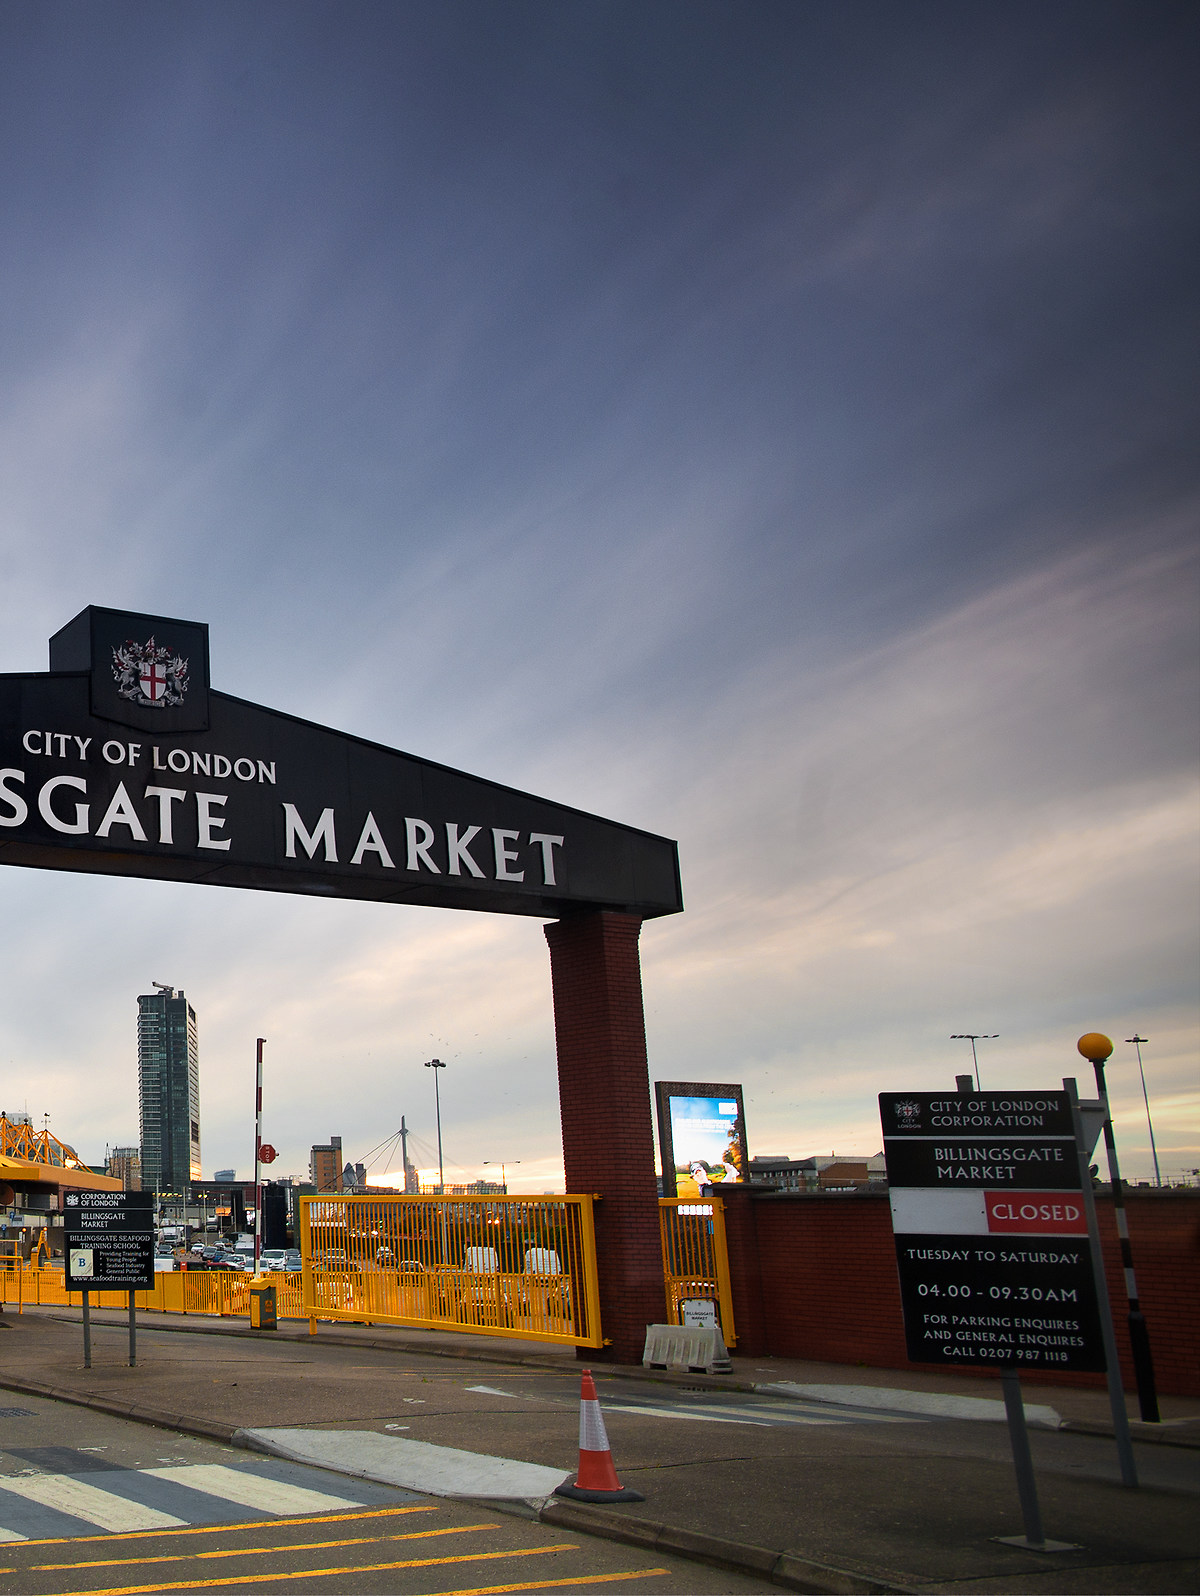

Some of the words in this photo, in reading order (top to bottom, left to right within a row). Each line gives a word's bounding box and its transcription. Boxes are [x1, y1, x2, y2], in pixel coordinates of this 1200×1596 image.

[22, 729, 93, 761] CITY
[101, 740, 142, 767] OF
[152, 746, 277, 784] LONDON
[282, 802, 565, 886] MARKET
[929, 1101, 962, 1112] CITY
[968, 1101, 987, 1112] OF
[992, 1100, 1059, 1112] LONDON
[931, 1116, 1044, 1127] CORPORATION
[934, 1148, 1064, 1161] BILLINGSGATE
[937, 1166, 1016, 1179] MARKET
[992, 1204, 1080, 1221] CLOSED
[78, 1258, 86, 1267] B
[907, 1249, 970, 1261] TUESDAY
[975, 1251, 996, 1261] TO
[1000, 1251, 1079, 1264] SATURDAY
[73, 1275, 148, 1283] www.seafoodtraining.org
[917, 1284, 971, 1298] 04.00
[989, 1286, 1077, 1302] 09.30AM
[923, 1314, 949, 1324] FOR
[952, 1315, 1011, 1327] PARKING
[1014, 1318, 1079, 1330] ENQUIRES
[923, 1330, 952, 1340] AND
[956, 1331, 1015, 1343] GENERAL
[1019, 1334, 1084, 1346] ENQUIRES
[943, 1346, 975, 1357] CALL
[979, 1348, 1012, 1358] 0207
[1016, 1350, 1040, 1360] 987
[1044, 1351, 1068, 1361] 1118
